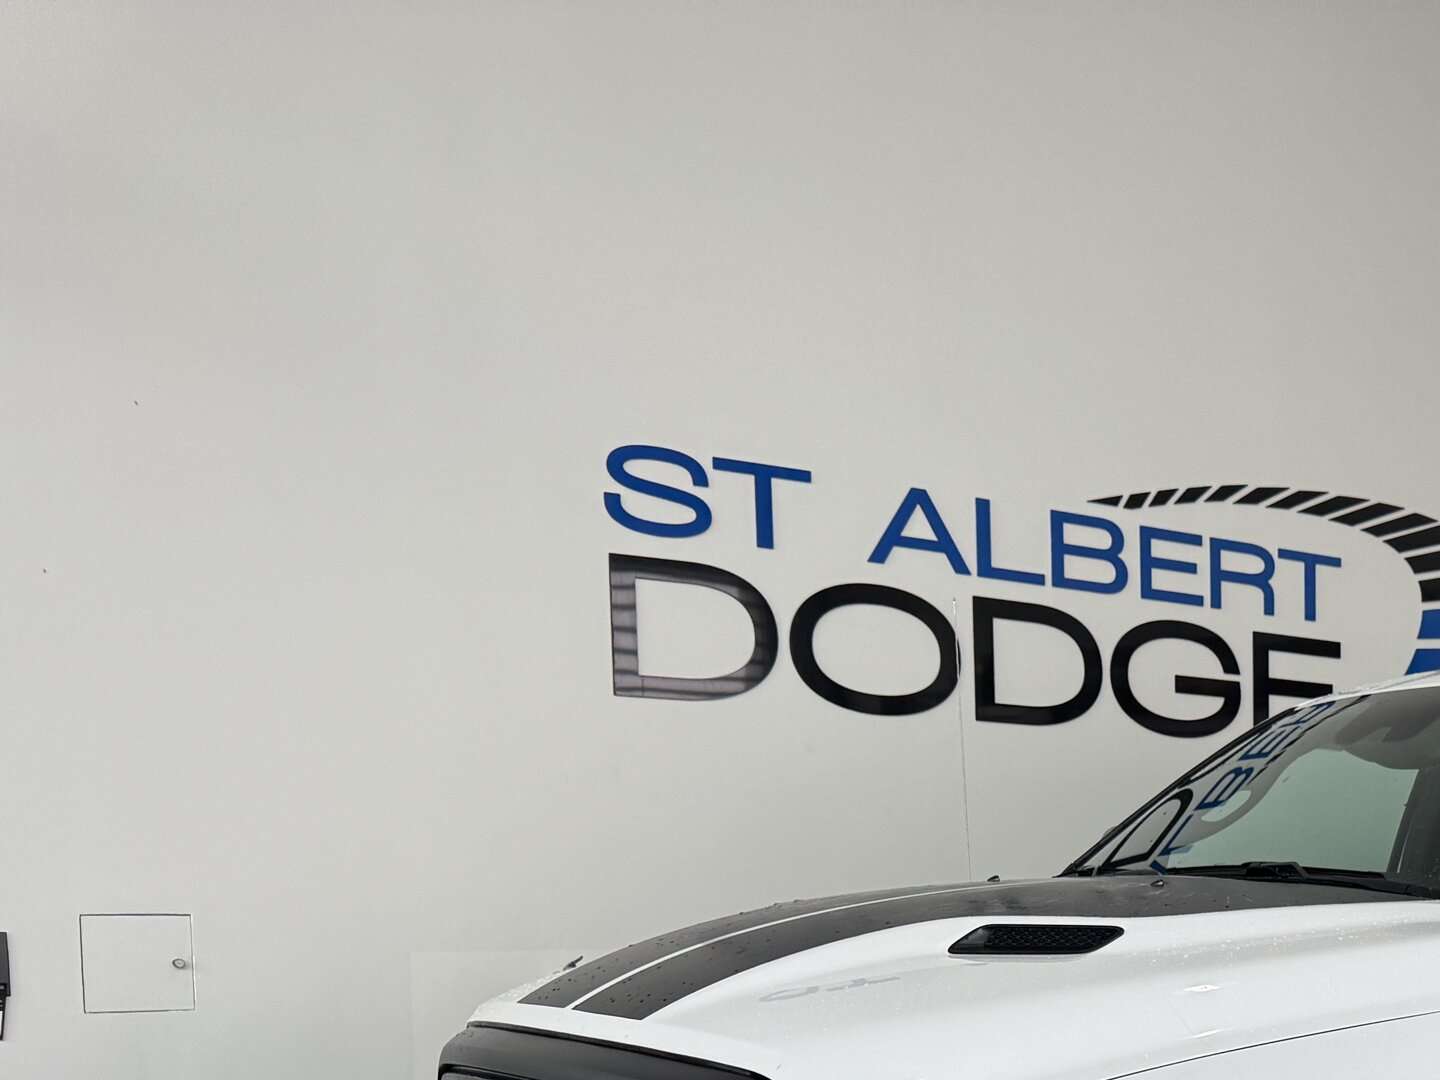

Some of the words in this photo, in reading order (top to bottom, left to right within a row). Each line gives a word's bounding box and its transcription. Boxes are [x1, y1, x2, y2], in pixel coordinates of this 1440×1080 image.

[602, 444, 812, 550] ST
[867, 487, 1342, 622] ALBERT
[609, 552, 1341, 738] DODGE
